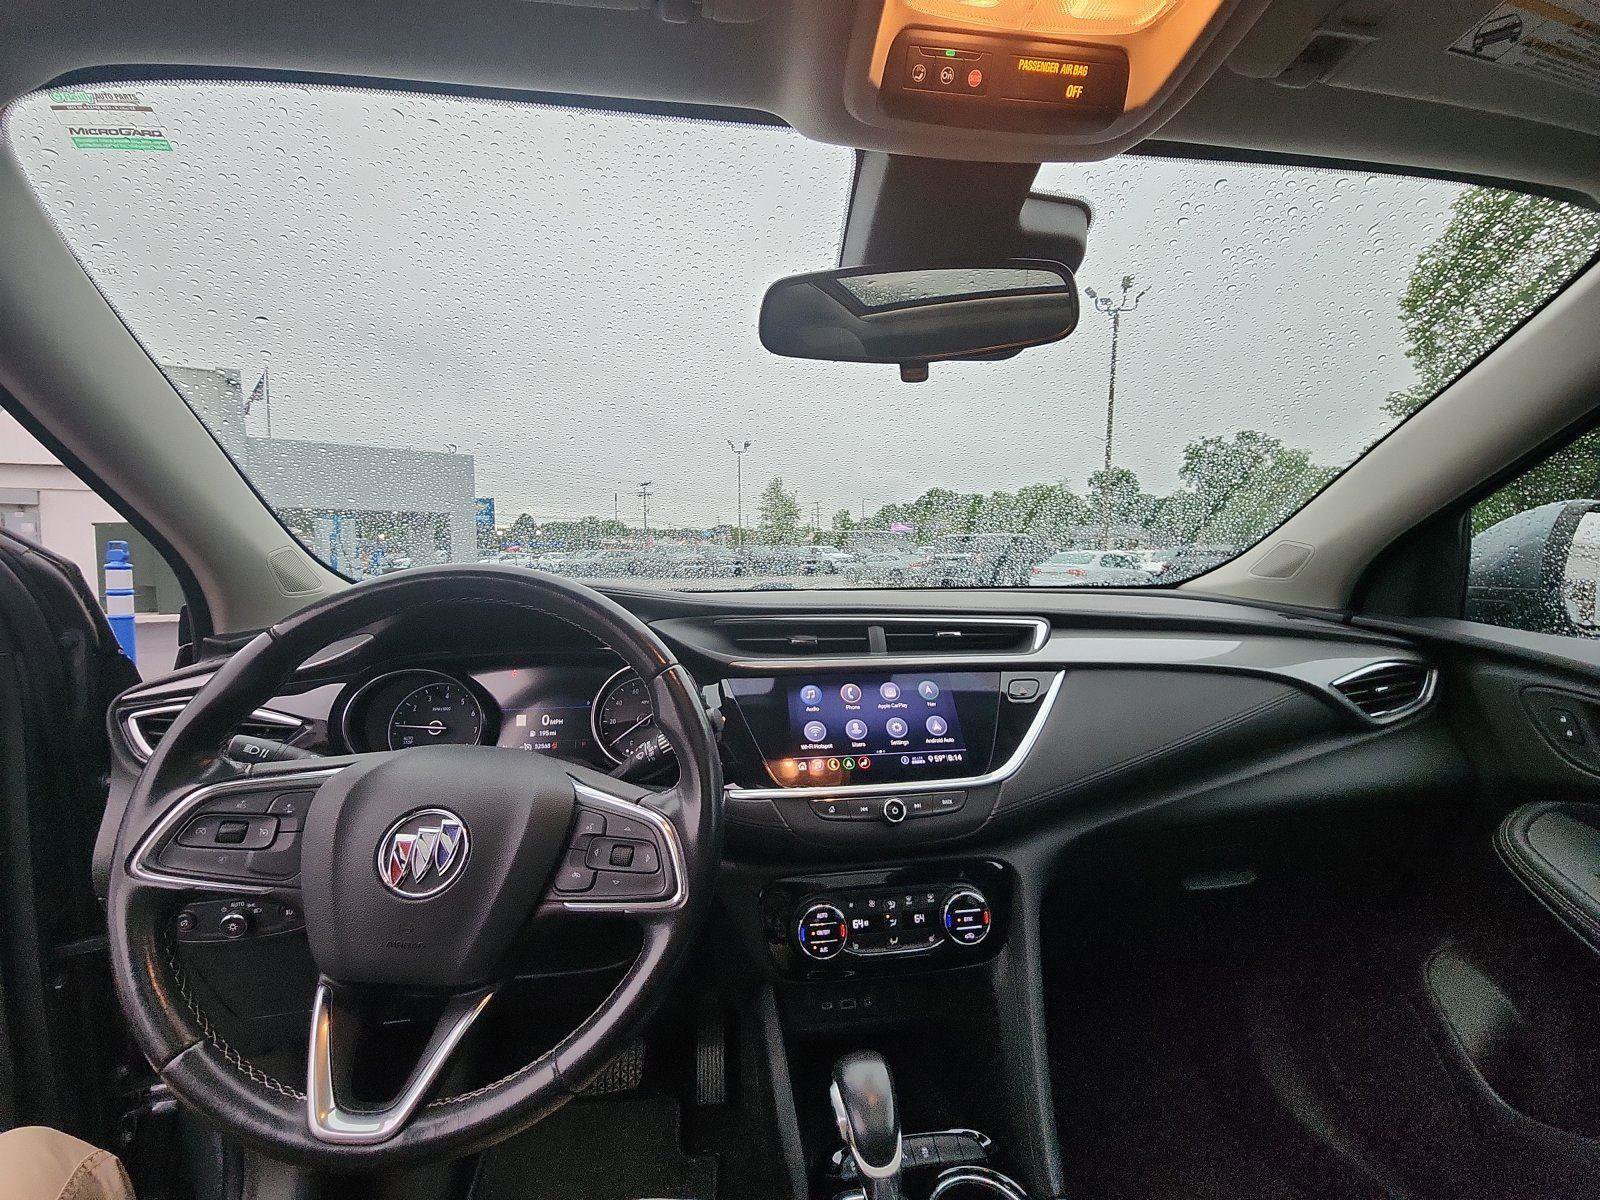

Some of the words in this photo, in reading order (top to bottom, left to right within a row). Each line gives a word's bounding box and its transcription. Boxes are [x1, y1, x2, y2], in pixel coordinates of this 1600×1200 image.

[1018, 59, 1060, 73] PASSENGER
[1060, 63, 1073, 75] AIR
[1073, 65, 1089, 76] BAG
[1065, 85, 1084, 98] OFF
[114, 93, 138, 101] PARTS
[460, 698, 466, 706] 5
[892, 702, 908, 710] CarPlay
[412, 704, 418, 712] 2
[470, 709, 477, 717] 6
[541, 714, 550, 726] 0
[473, 726, 478, 734] 7
[890, 739, 910, 747] Settings
[913, 913, 925, 924] 64
[852, 919, 864, 930] 64
